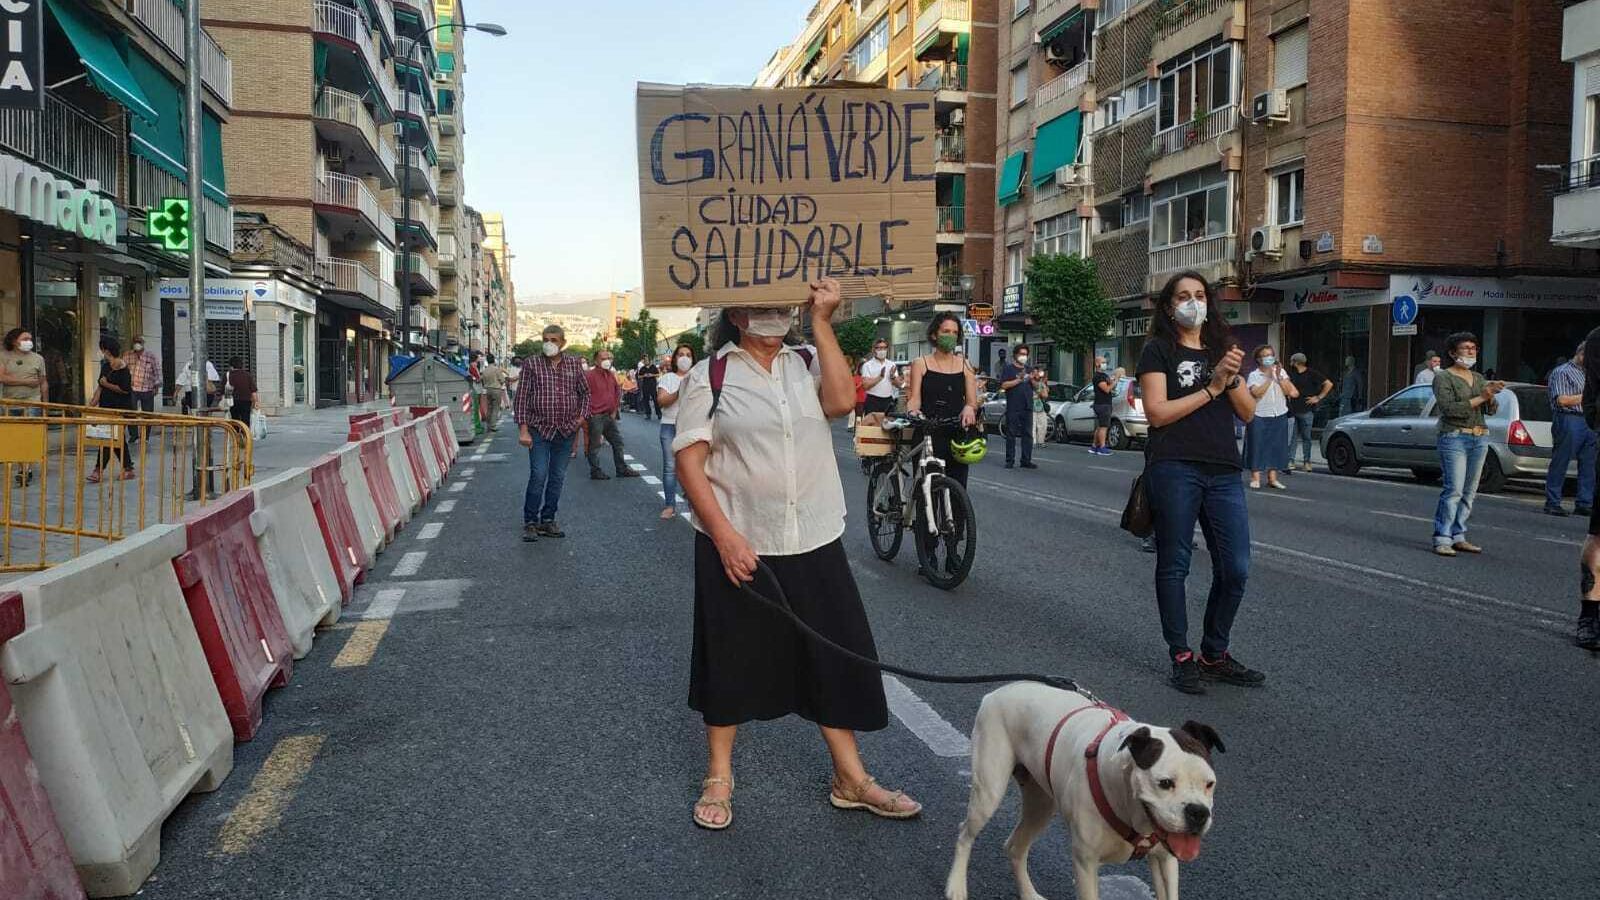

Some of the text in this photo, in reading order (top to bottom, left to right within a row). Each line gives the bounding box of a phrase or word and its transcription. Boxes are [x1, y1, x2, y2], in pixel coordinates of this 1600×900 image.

[650, 92, 937, 186] GRANÁ VERDE
[668, 219, 913, 290] SALUDABLE
